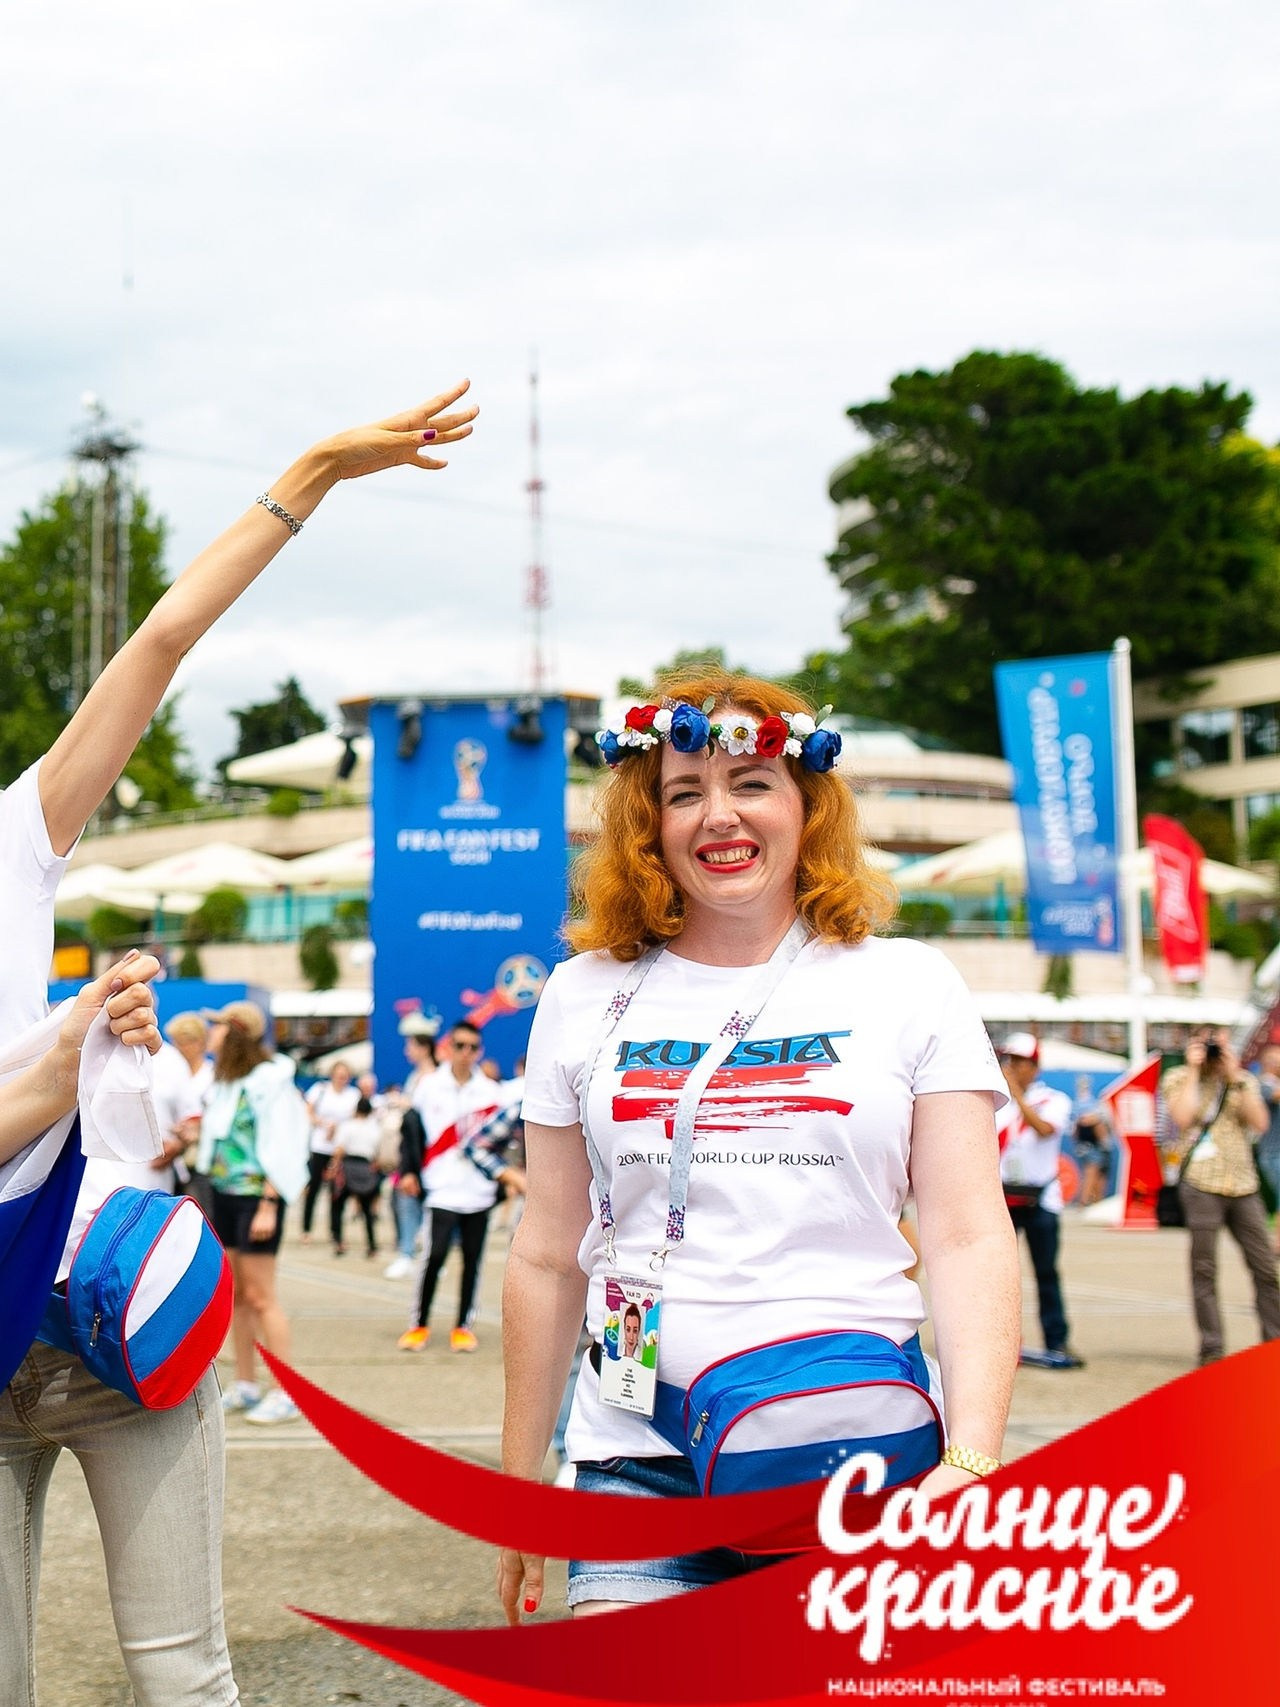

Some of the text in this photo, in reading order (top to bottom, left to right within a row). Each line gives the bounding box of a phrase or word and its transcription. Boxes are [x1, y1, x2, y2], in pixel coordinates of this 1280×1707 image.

[618, 1034, 841, 1066] RUSIA
[690, 1151, 737, 1164] ORLD
[741, 1152, 774, 1165] CUP
